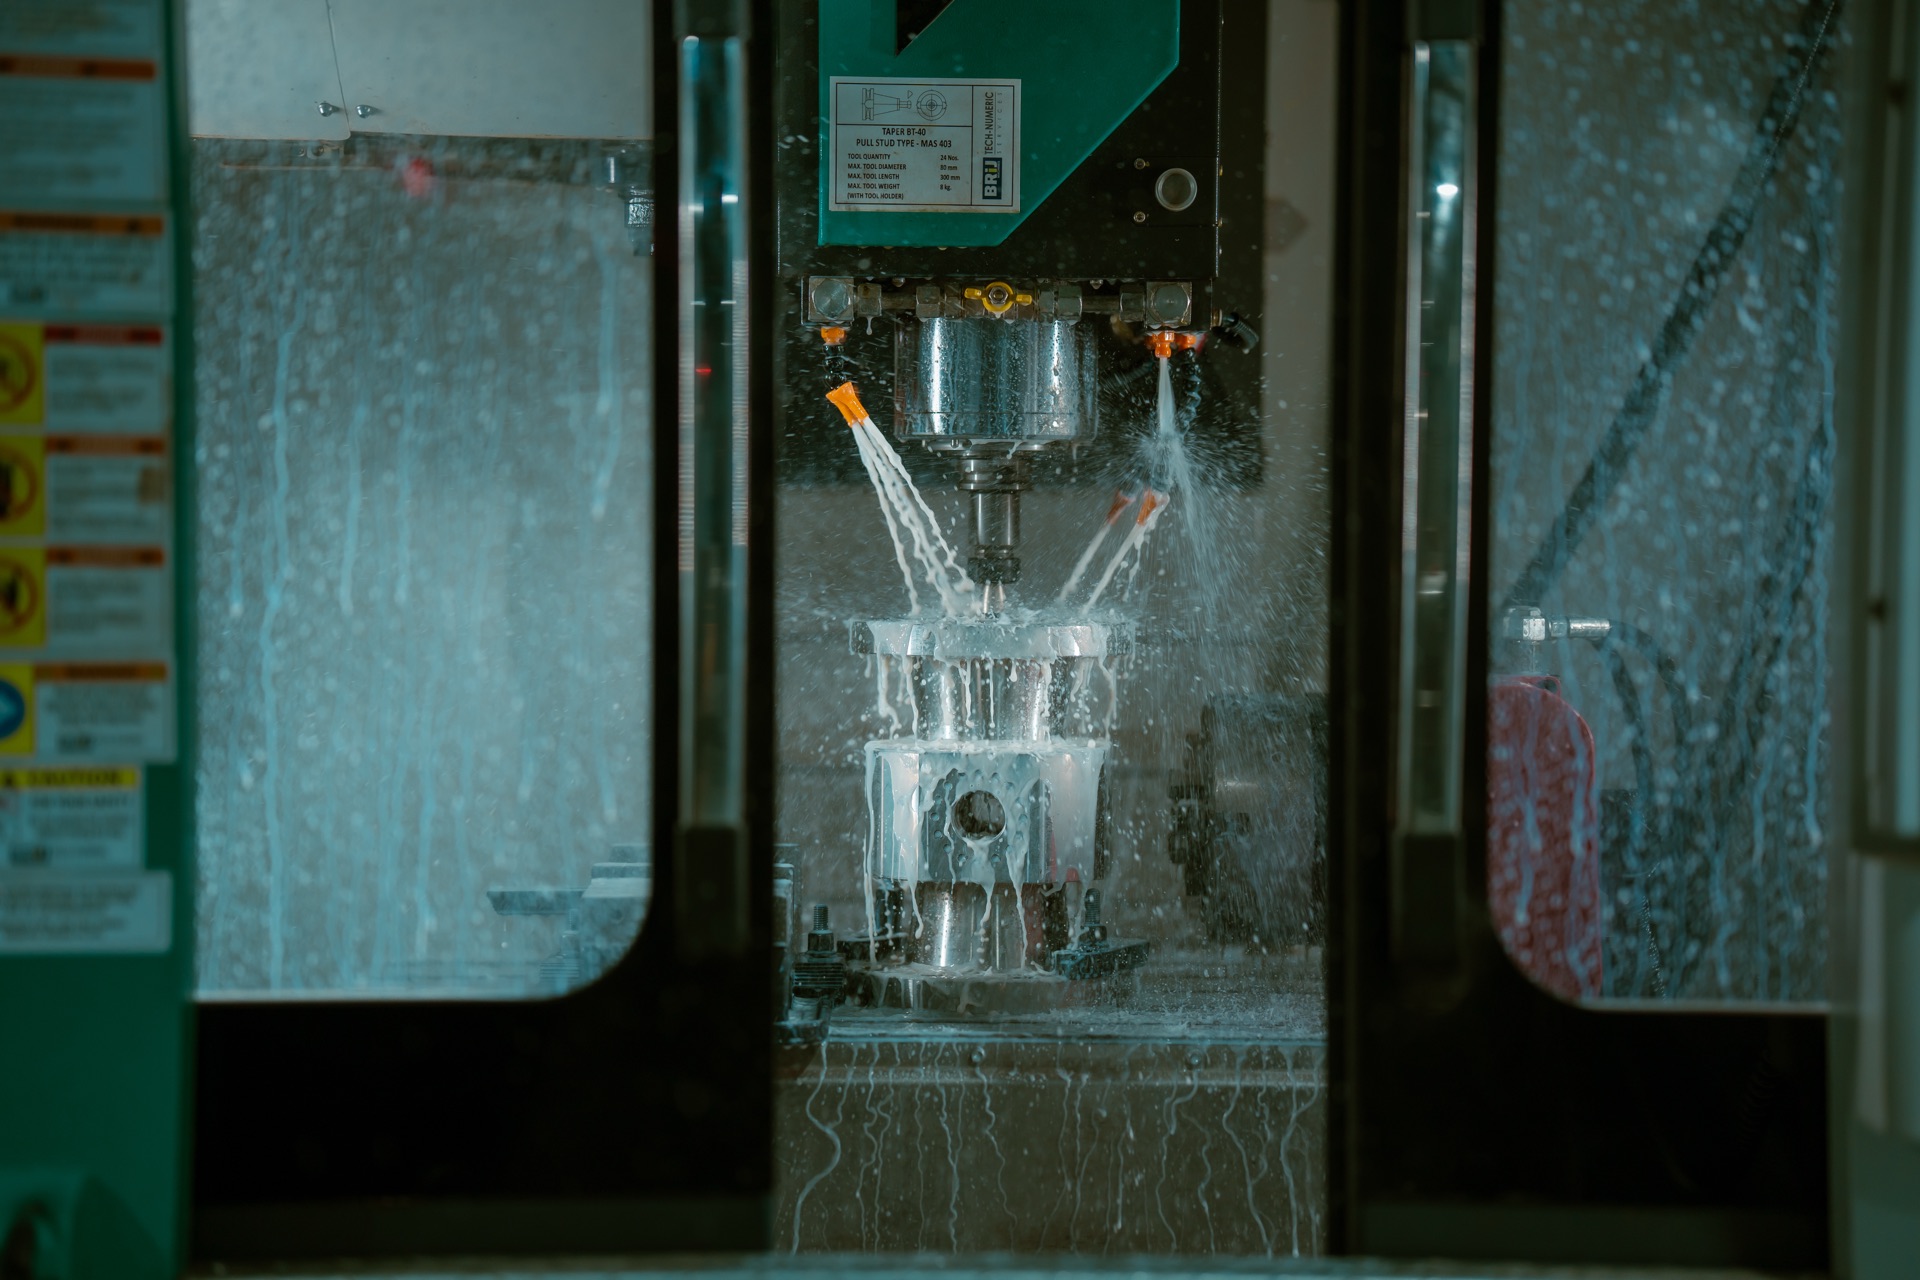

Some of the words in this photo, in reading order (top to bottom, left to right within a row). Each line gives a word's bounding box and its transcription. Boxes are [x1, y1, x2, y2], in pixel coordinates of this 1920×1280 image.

[984, 92, 994, 154] TECH-NUMERIC
[882, 127, 905, 135] TAPER
[856, 138, 874, 146] PULL
[875, 139, 895, 147] STUD
[921, 140, 937, 148] MAS
